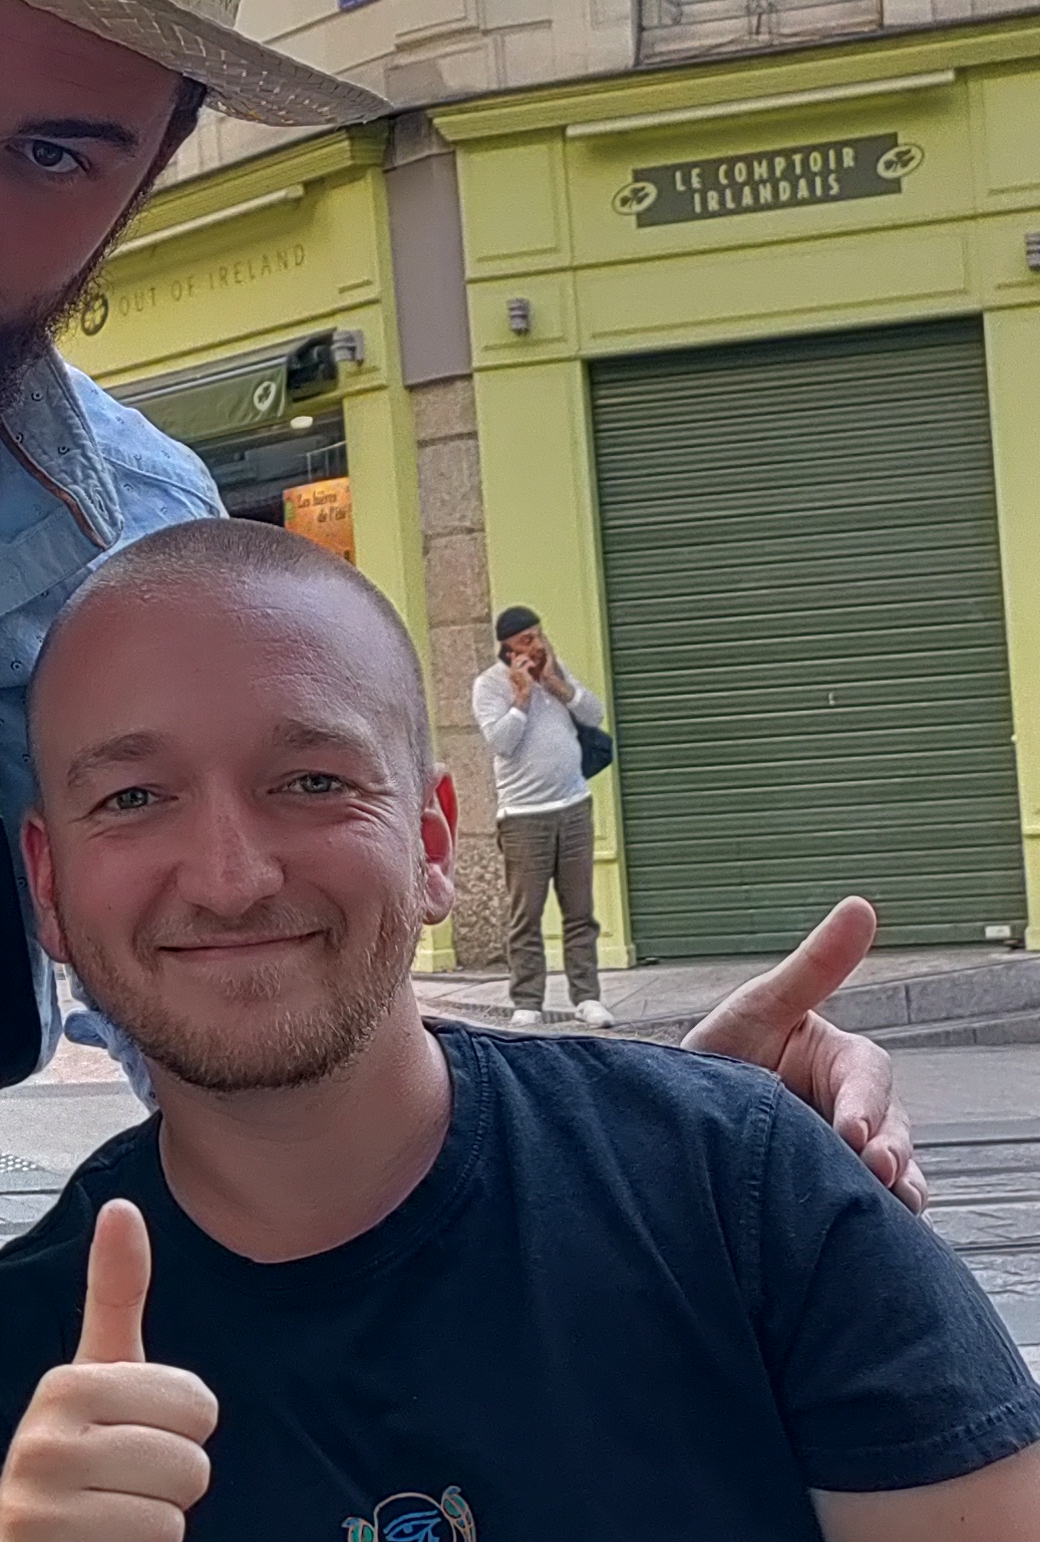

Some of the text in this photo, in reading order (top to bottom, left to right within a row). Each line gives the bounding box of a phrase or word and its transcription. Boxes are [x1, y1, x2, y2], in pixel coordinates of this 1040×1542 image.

[674, 147, 854, 192] LE COMPTOIR
[693, 173, 840, 214] IRLANDAIS
[118, 243, 306, 317] OUT OF IRELAND
